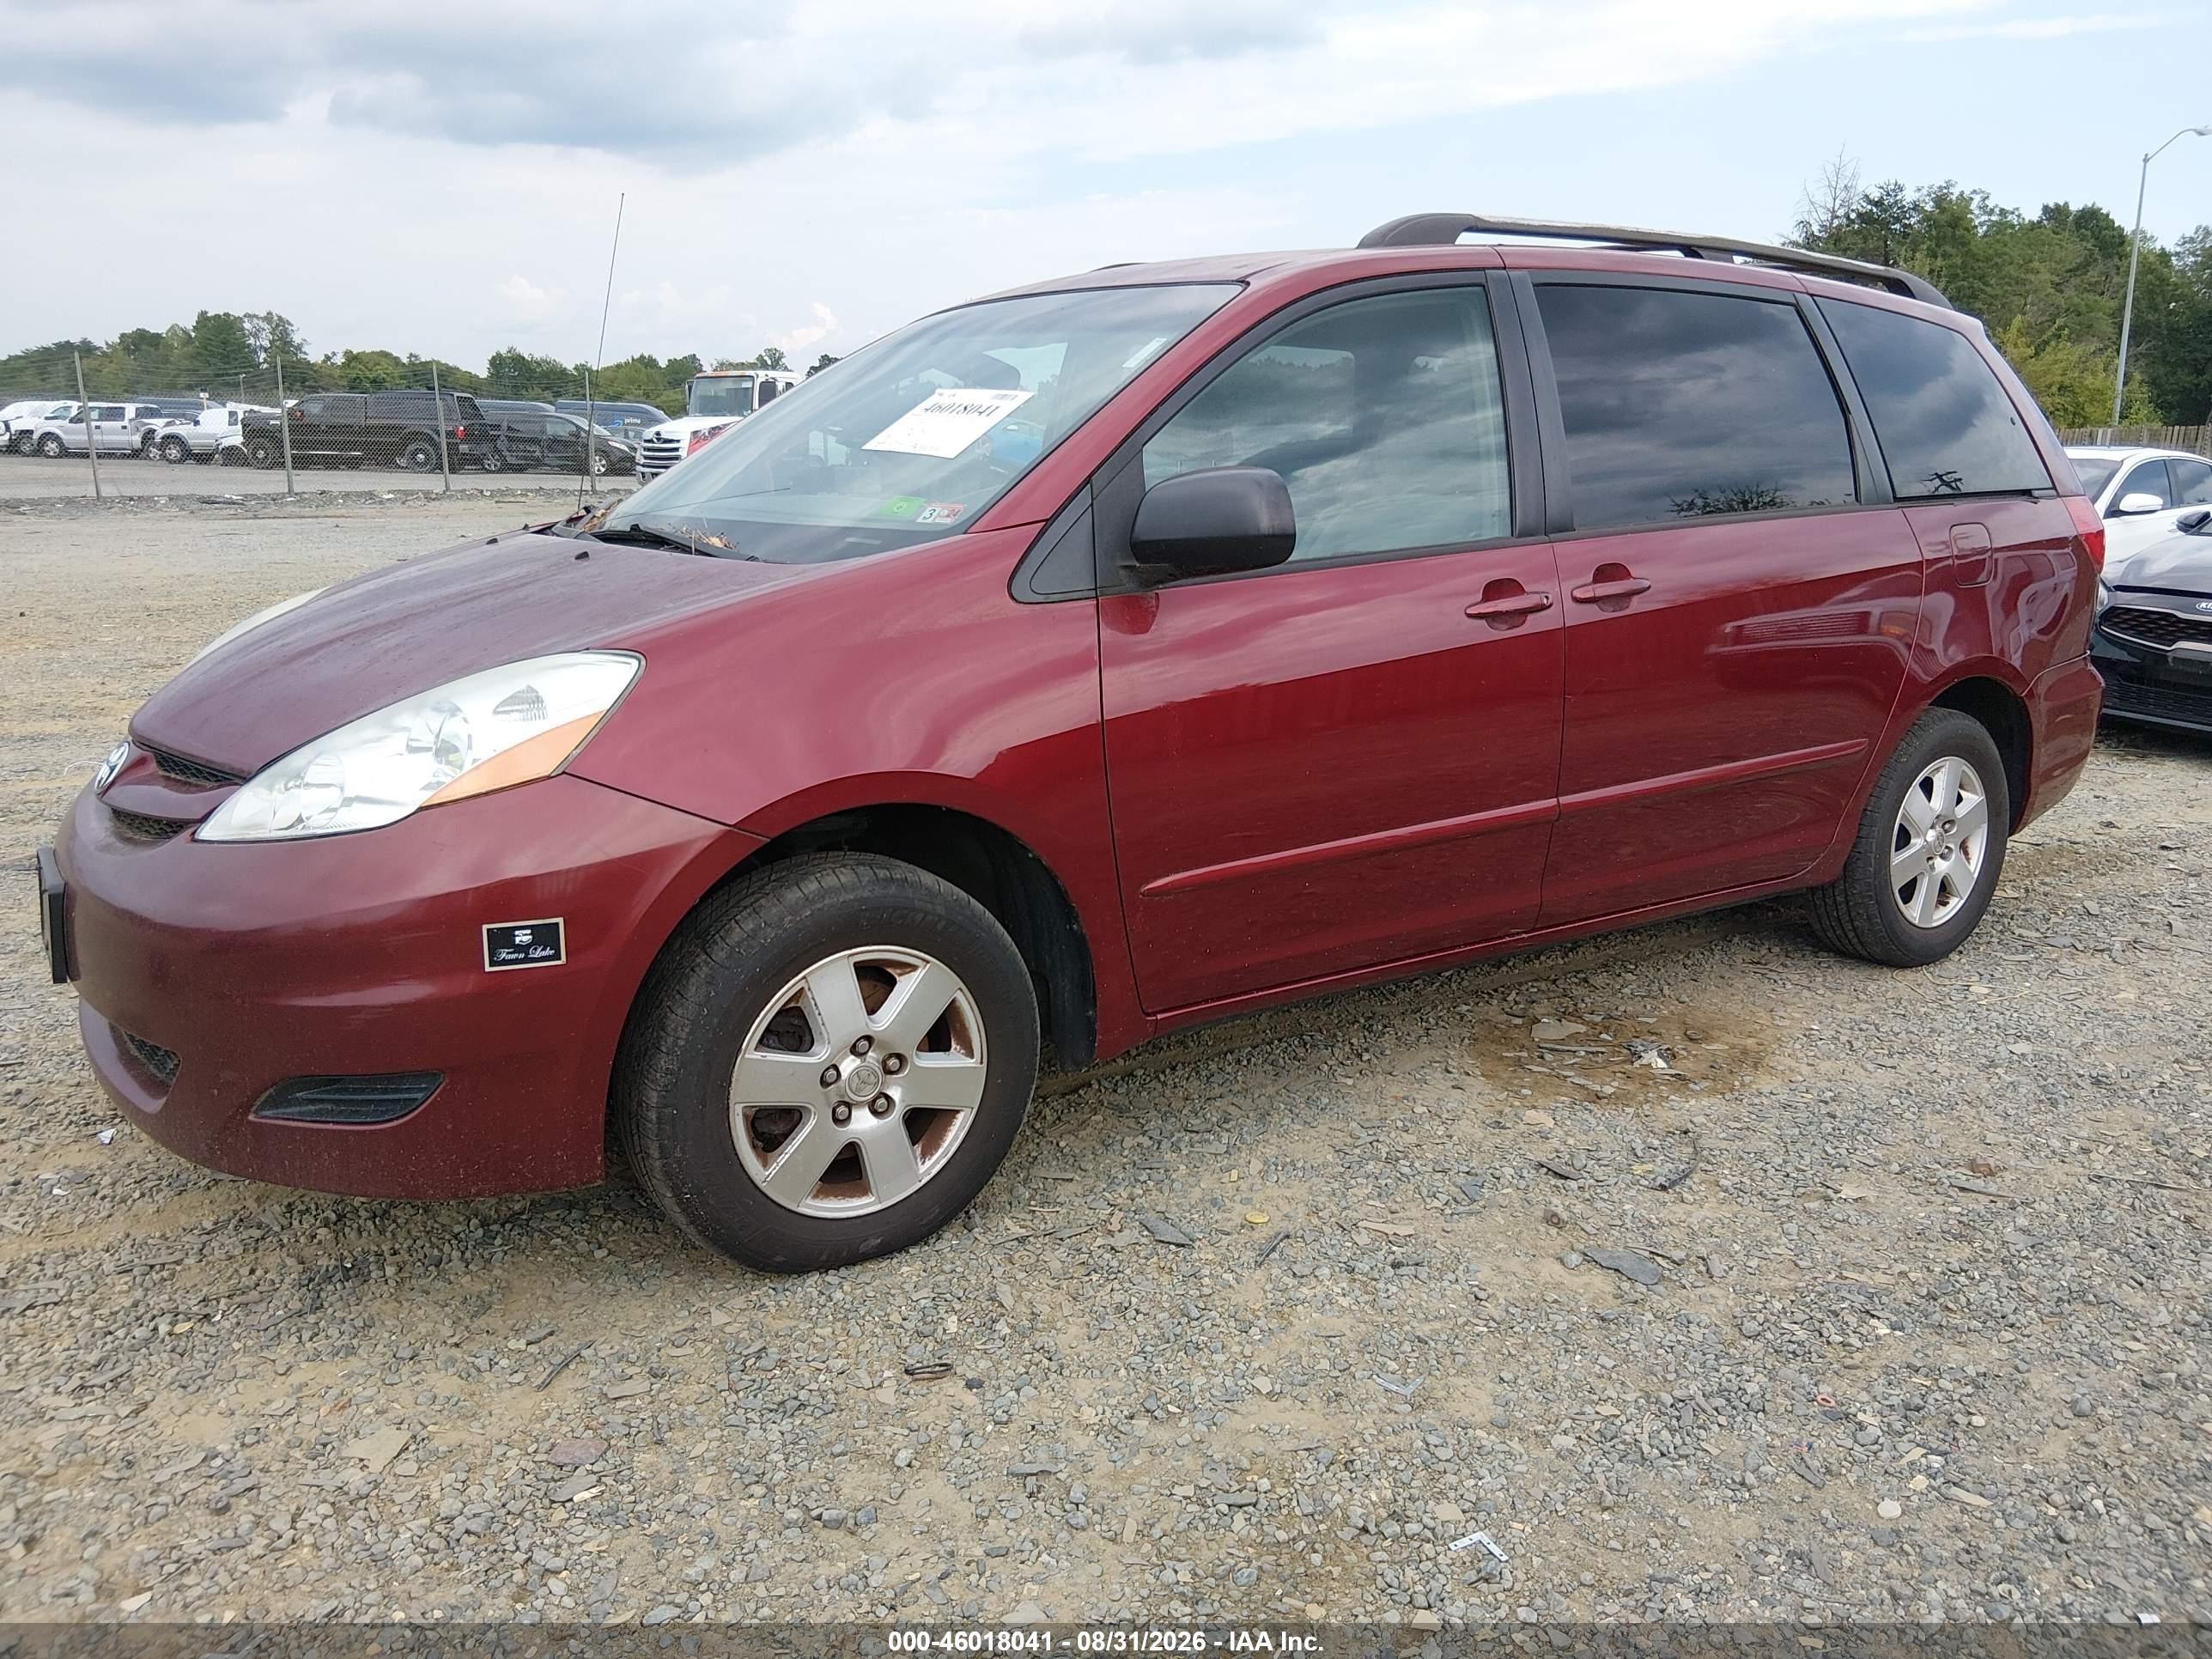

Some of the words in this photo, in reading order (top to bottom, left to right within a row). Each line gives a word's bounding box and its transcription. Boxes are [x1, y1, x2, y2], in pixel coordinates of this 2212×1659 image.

[924, 402, 1000, 416] 46018041
[922, 508, 936, 520] 3
[494, 948, 526, 961] Fawn
[527, 945, 556, 958] Lake
